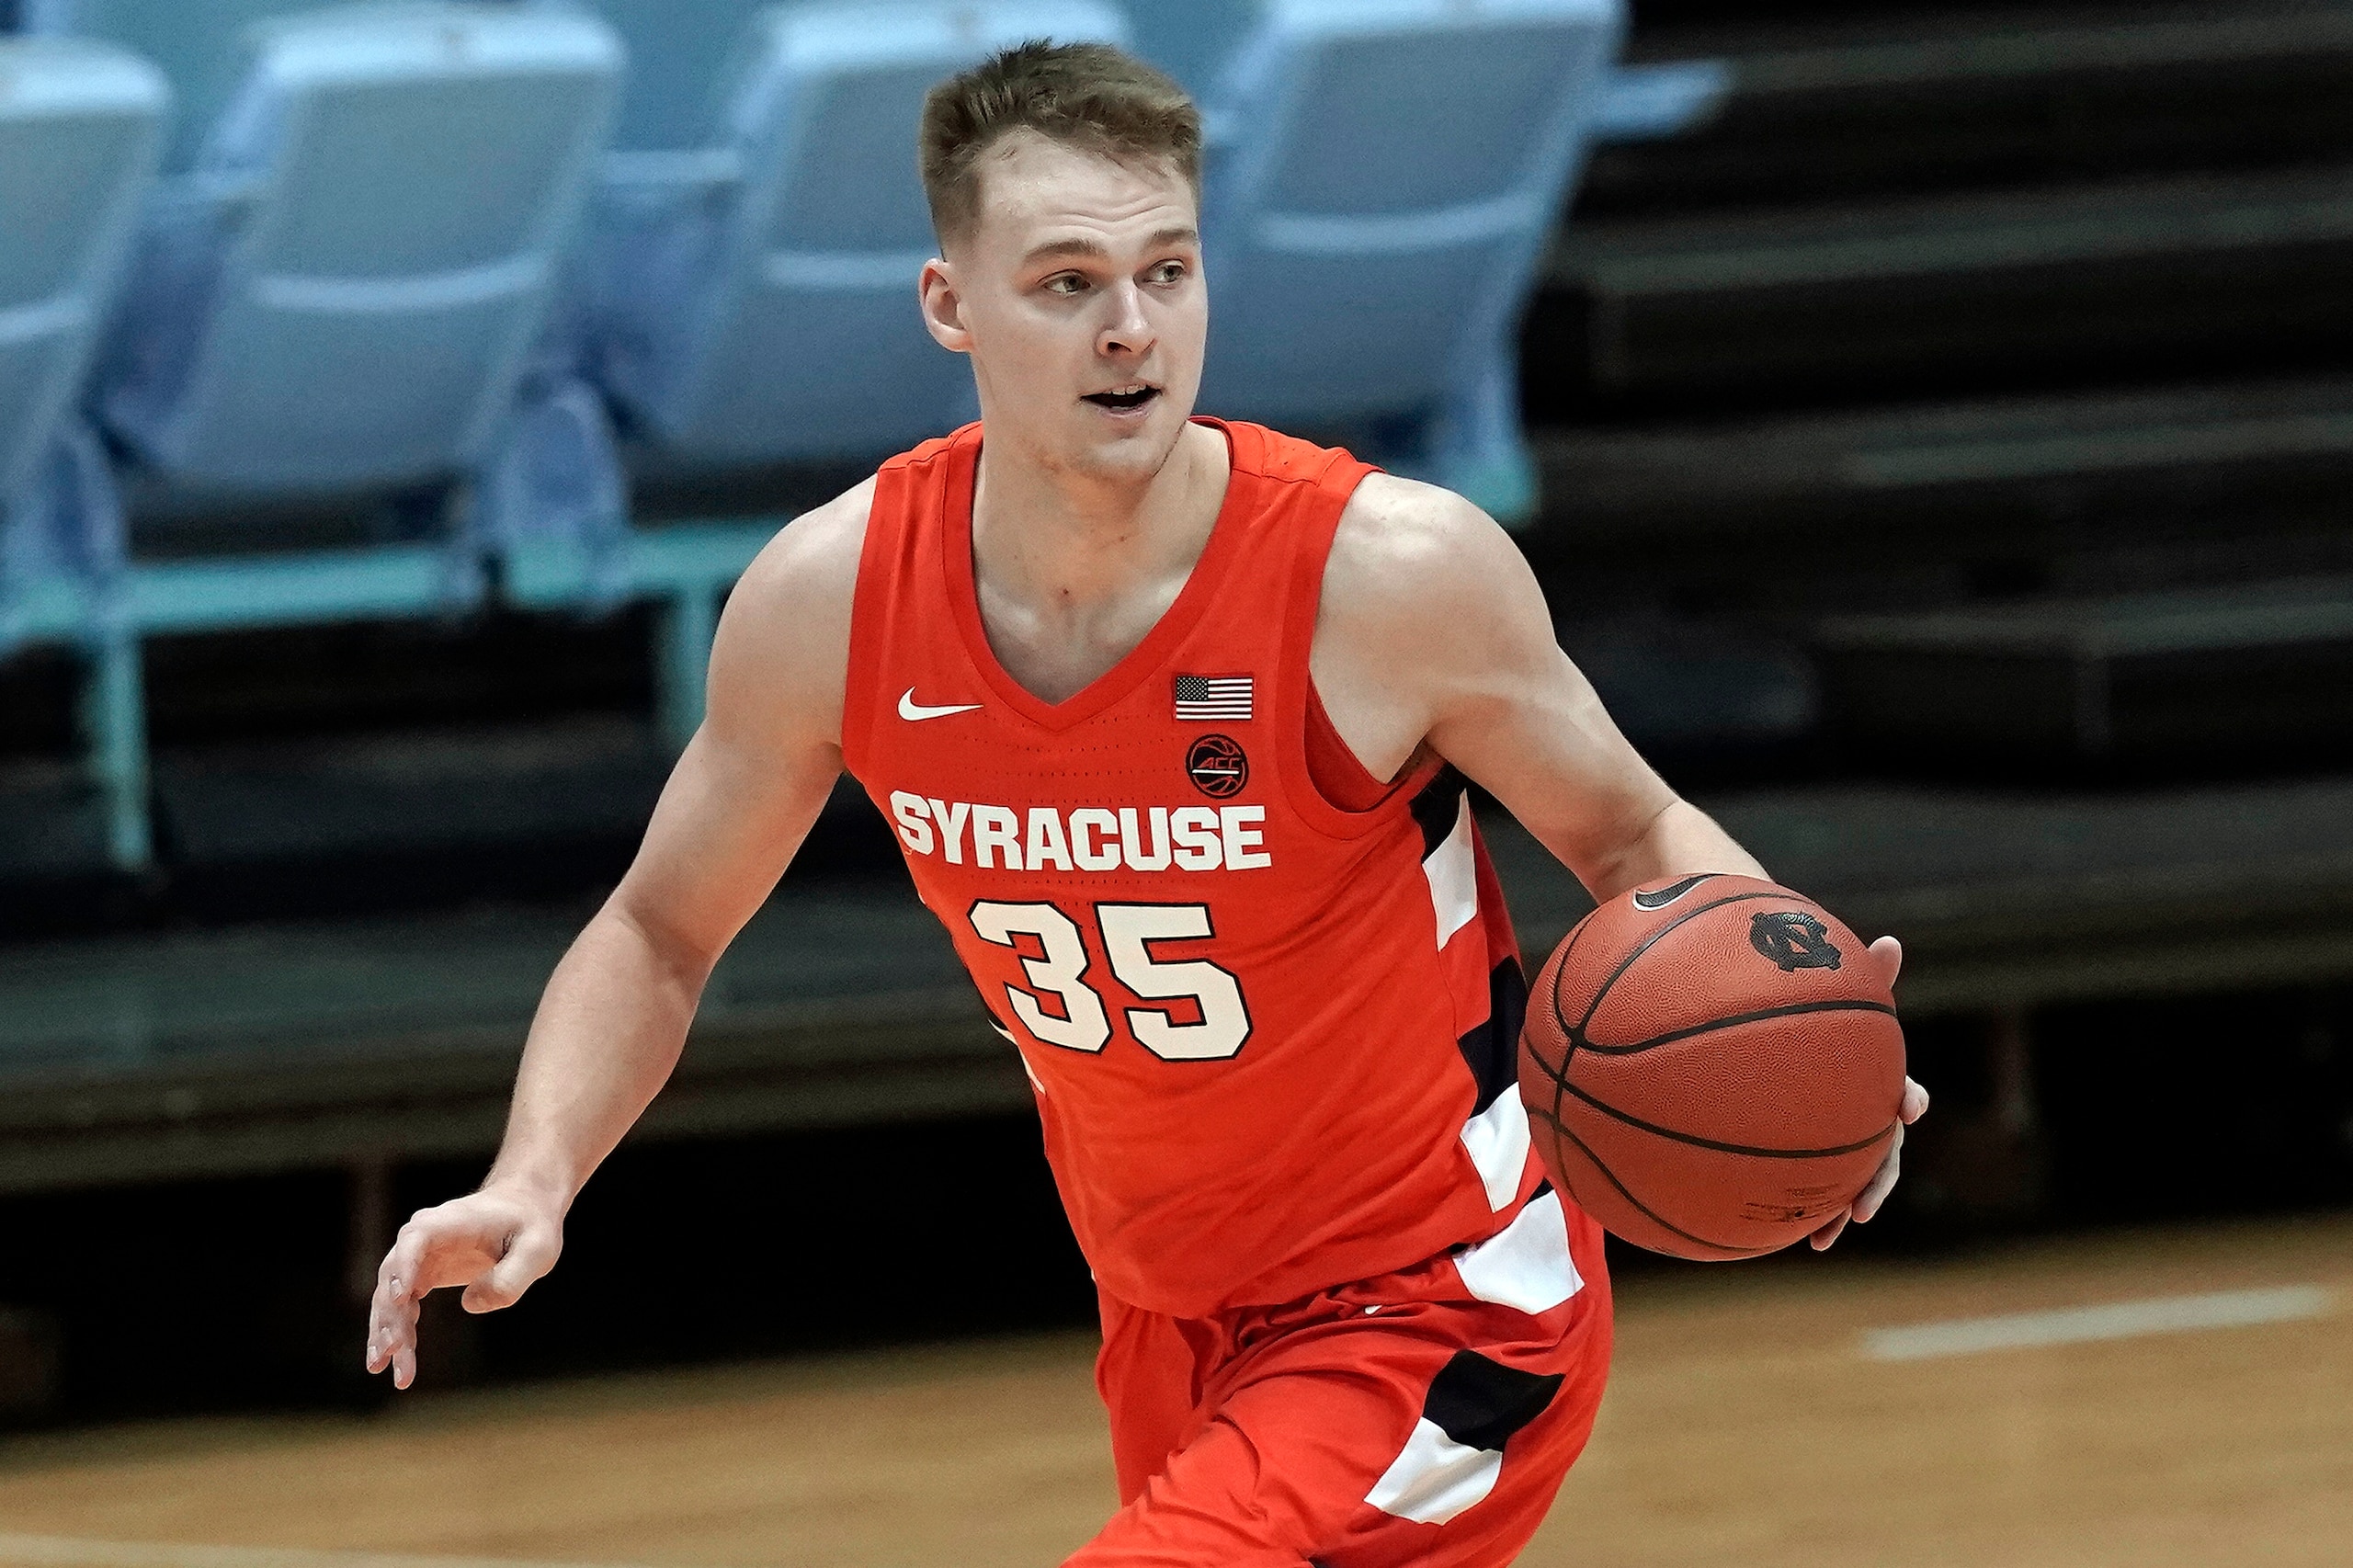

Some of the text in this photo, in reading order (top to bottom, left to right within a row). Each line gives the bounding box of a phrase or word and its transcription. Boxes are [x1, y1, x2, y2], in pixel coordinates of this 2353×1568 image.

[1198, 756, 1240, 769] ACC
[889, 790, 1272, 871] SYRACUSE
[968, 899, 1253, 1061] 35
